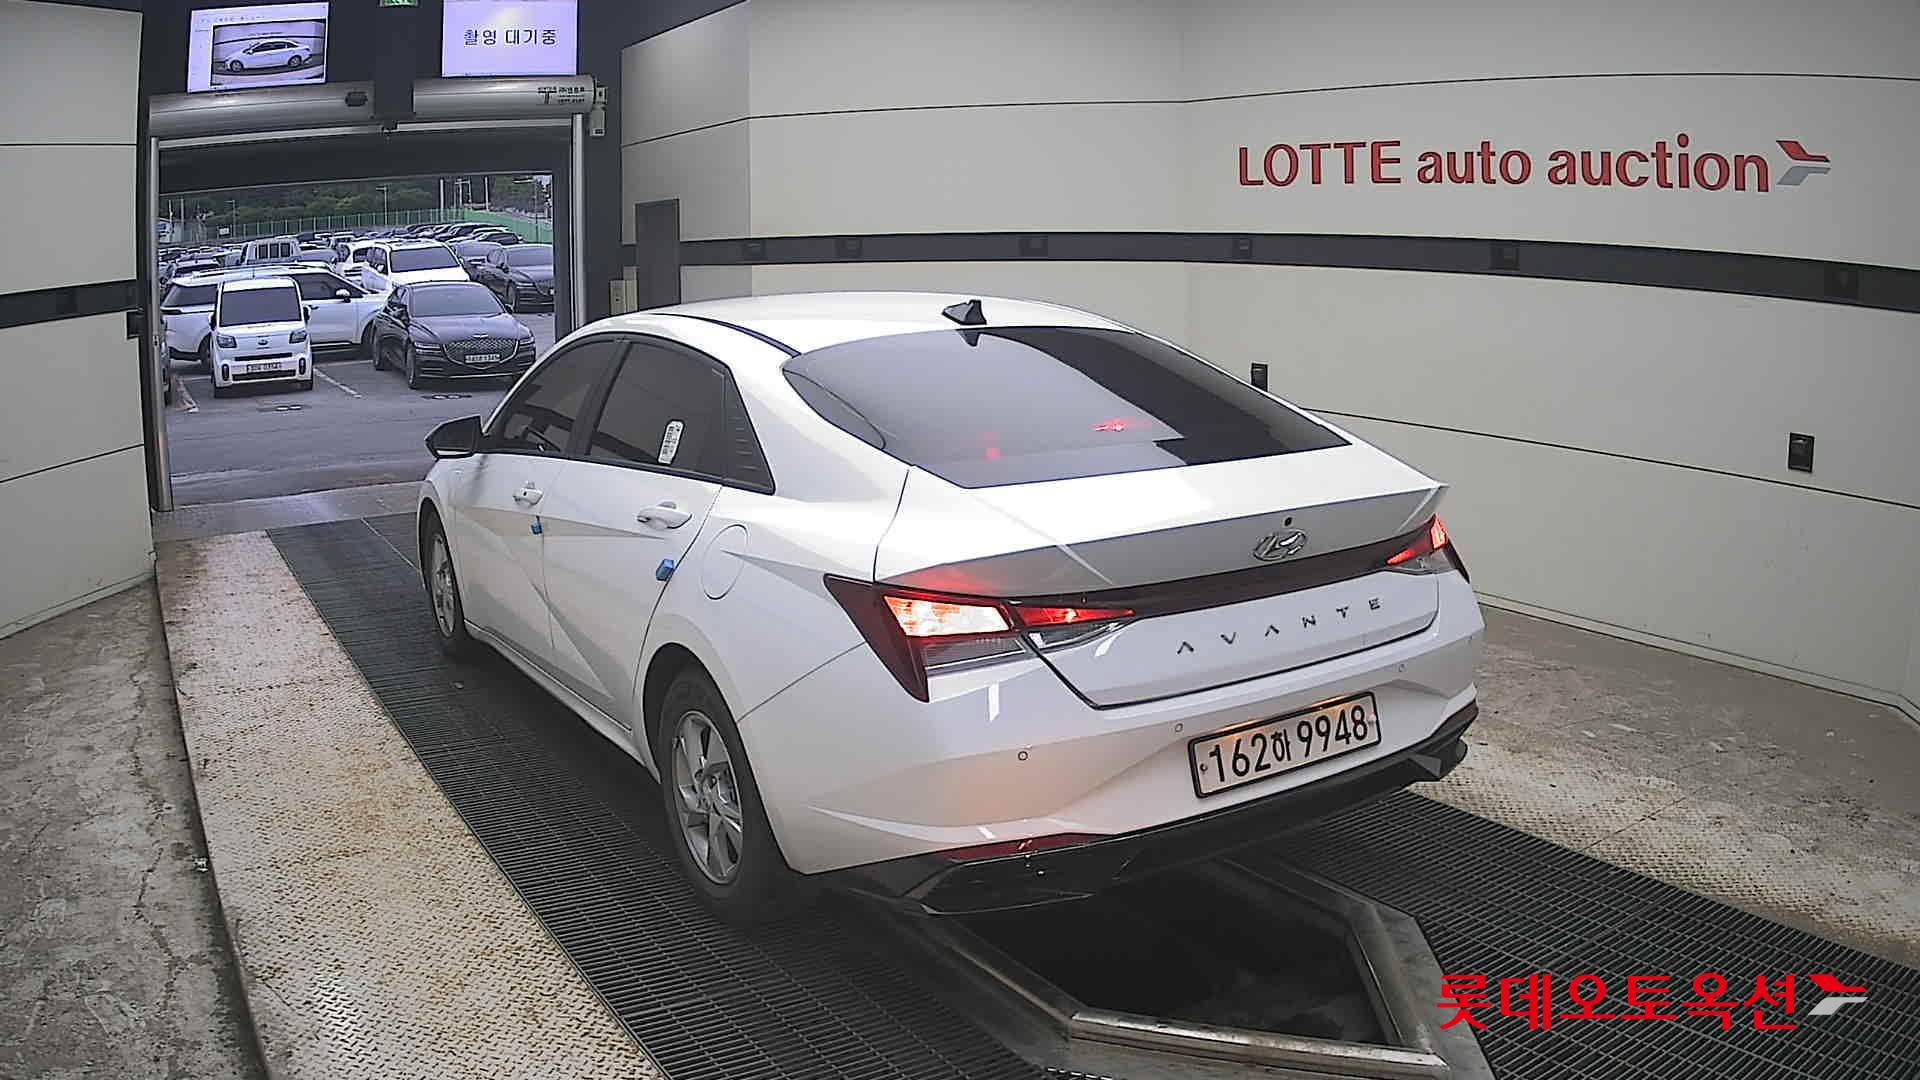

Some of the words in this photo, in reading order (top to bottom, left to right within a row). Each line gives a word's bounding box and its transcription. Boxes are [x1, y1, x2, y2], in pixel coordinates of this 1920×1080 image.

[464, 29, 497, 46] 촬영
[504, 29, 557, 46] 대기중
[1239, 141, 1401, 186] LOTTE
[1417, 141, 1531, 185] auto
[1547, 133, 1769, 193] auction
[1177, 598, 1381, 655] AVANTE
[1297, 705, 1368, 758] 9948
